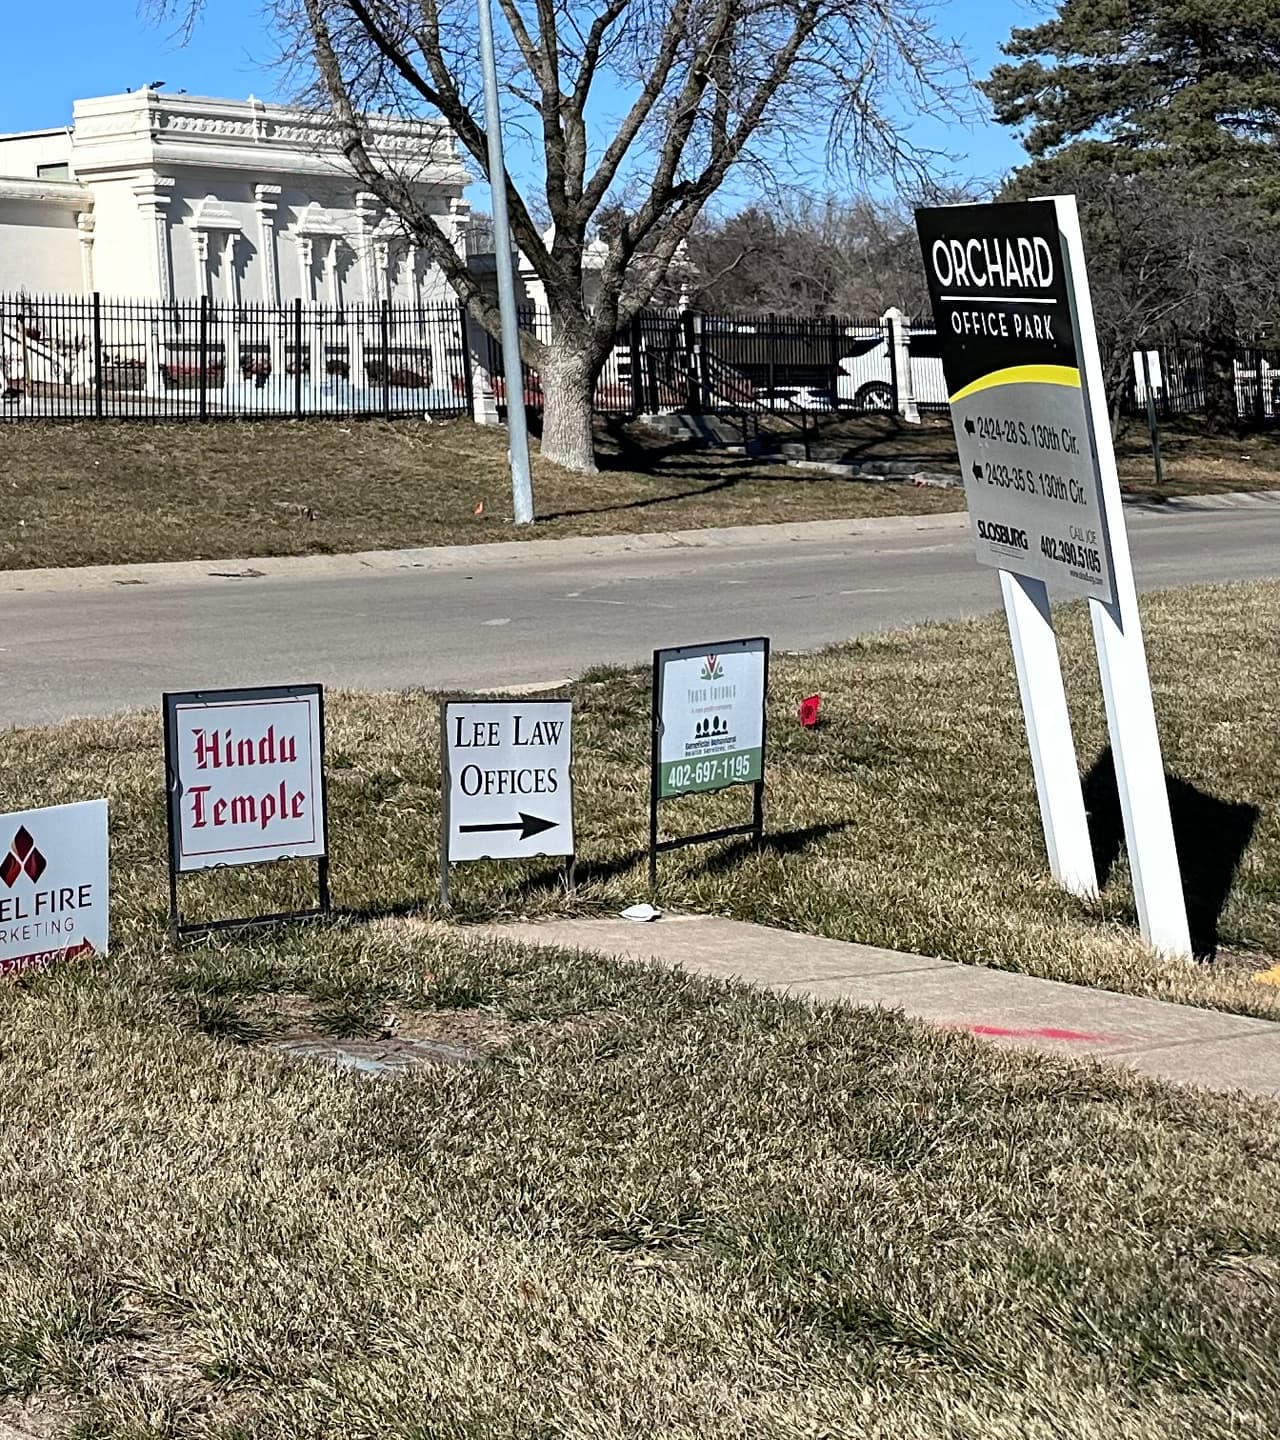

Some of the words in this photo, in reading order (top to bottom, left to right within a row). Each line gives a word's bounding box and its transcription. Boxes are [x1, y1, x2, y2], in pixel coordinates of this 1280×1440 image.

[932, 236, 1054, 288] ORCHARD
[951, 310, 1009, 337] OFFICE
[1013, 313, 1055, 340] PARK
[977, 416, 1018, 444] 2424-28
[1018, 421, 1031, 446] S.
[1031, 424, 1061, 451] 130th
[1061, 428, 1080, 455] Cir.
[985, 462, 1026, 492] 2433-35
[1026, 470, 1039, 495] S.
[1039, 473, 1068, 501] 130th
[1068, 478, 1088, 505] Cir.
[977, 519, 1029, 550] SLOSBURG
[1040, 535, 1102, 573] 402.390.5105
[191, 724, 297, 769] Hindu
[668, 755, 751, 788] 402-697-1195
[185, 780, 306, 830] Temple
[35, 884, 93, 916] FIRE
